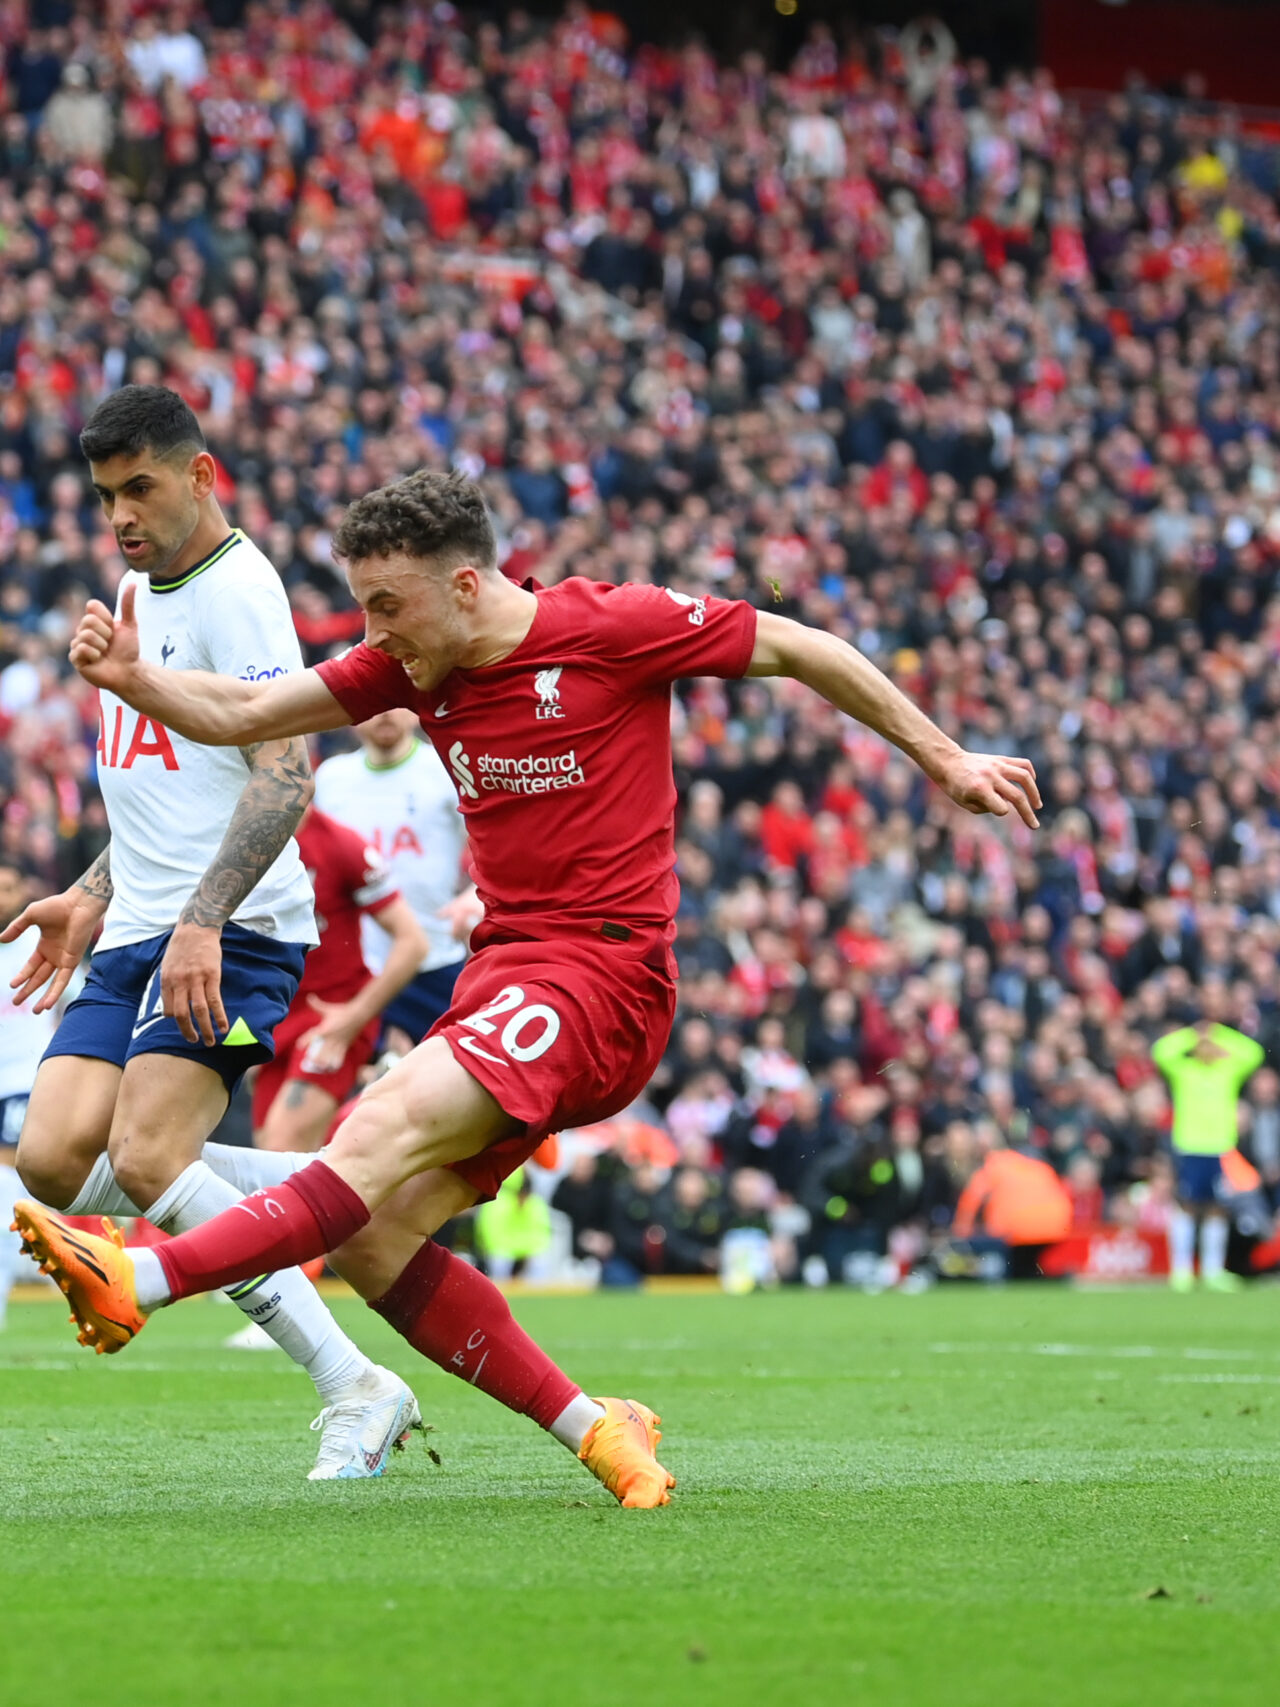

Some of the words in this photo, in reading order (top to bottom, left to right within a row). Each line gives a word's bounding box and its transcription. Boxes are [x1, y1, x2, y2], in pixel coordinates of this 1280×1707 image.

[477, 749, 577, 775] standard
[481, 765, 586, 795] chartered
[456, 985, 561, 1062] 20
